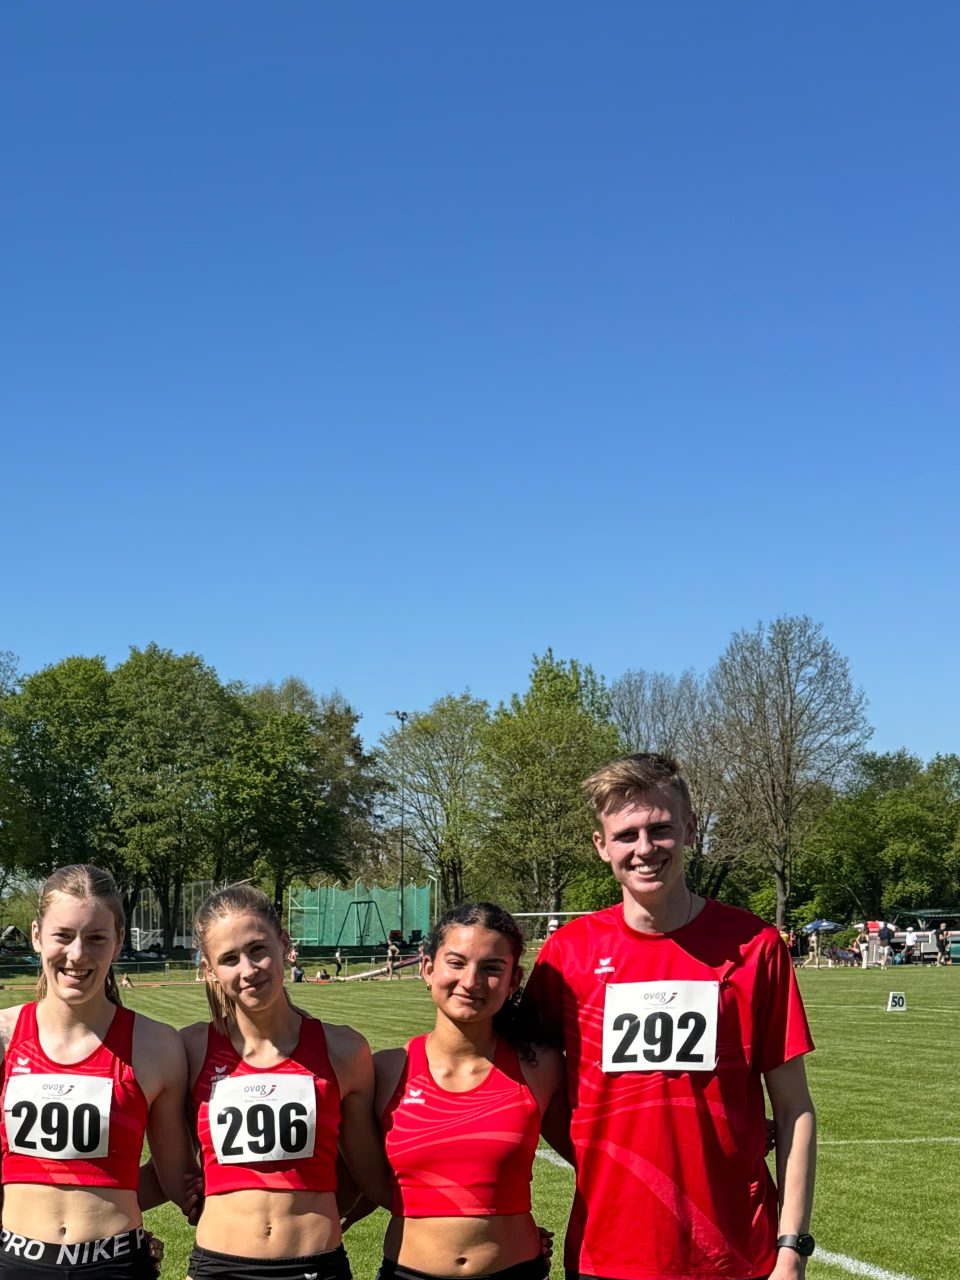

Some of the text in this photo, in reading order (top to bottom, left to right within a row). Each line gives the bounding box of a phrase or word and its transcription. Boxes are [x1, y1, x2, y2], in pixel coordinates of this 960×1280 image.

[643, 991, 667, 1003] ovag
[891, 996, 905, 1008] 50
[611, 1011, 707, 1063] 292
[42, 1083, 65, 1095] ovag
[244, 1084, 267, 1096] ovag
[11, 1100, 101, 1153] 290
[217, 1102, 308, 1156] 296
[0, 1229, 45, 1261] PRO
[56, 1232, 130, 1265] NIKE
